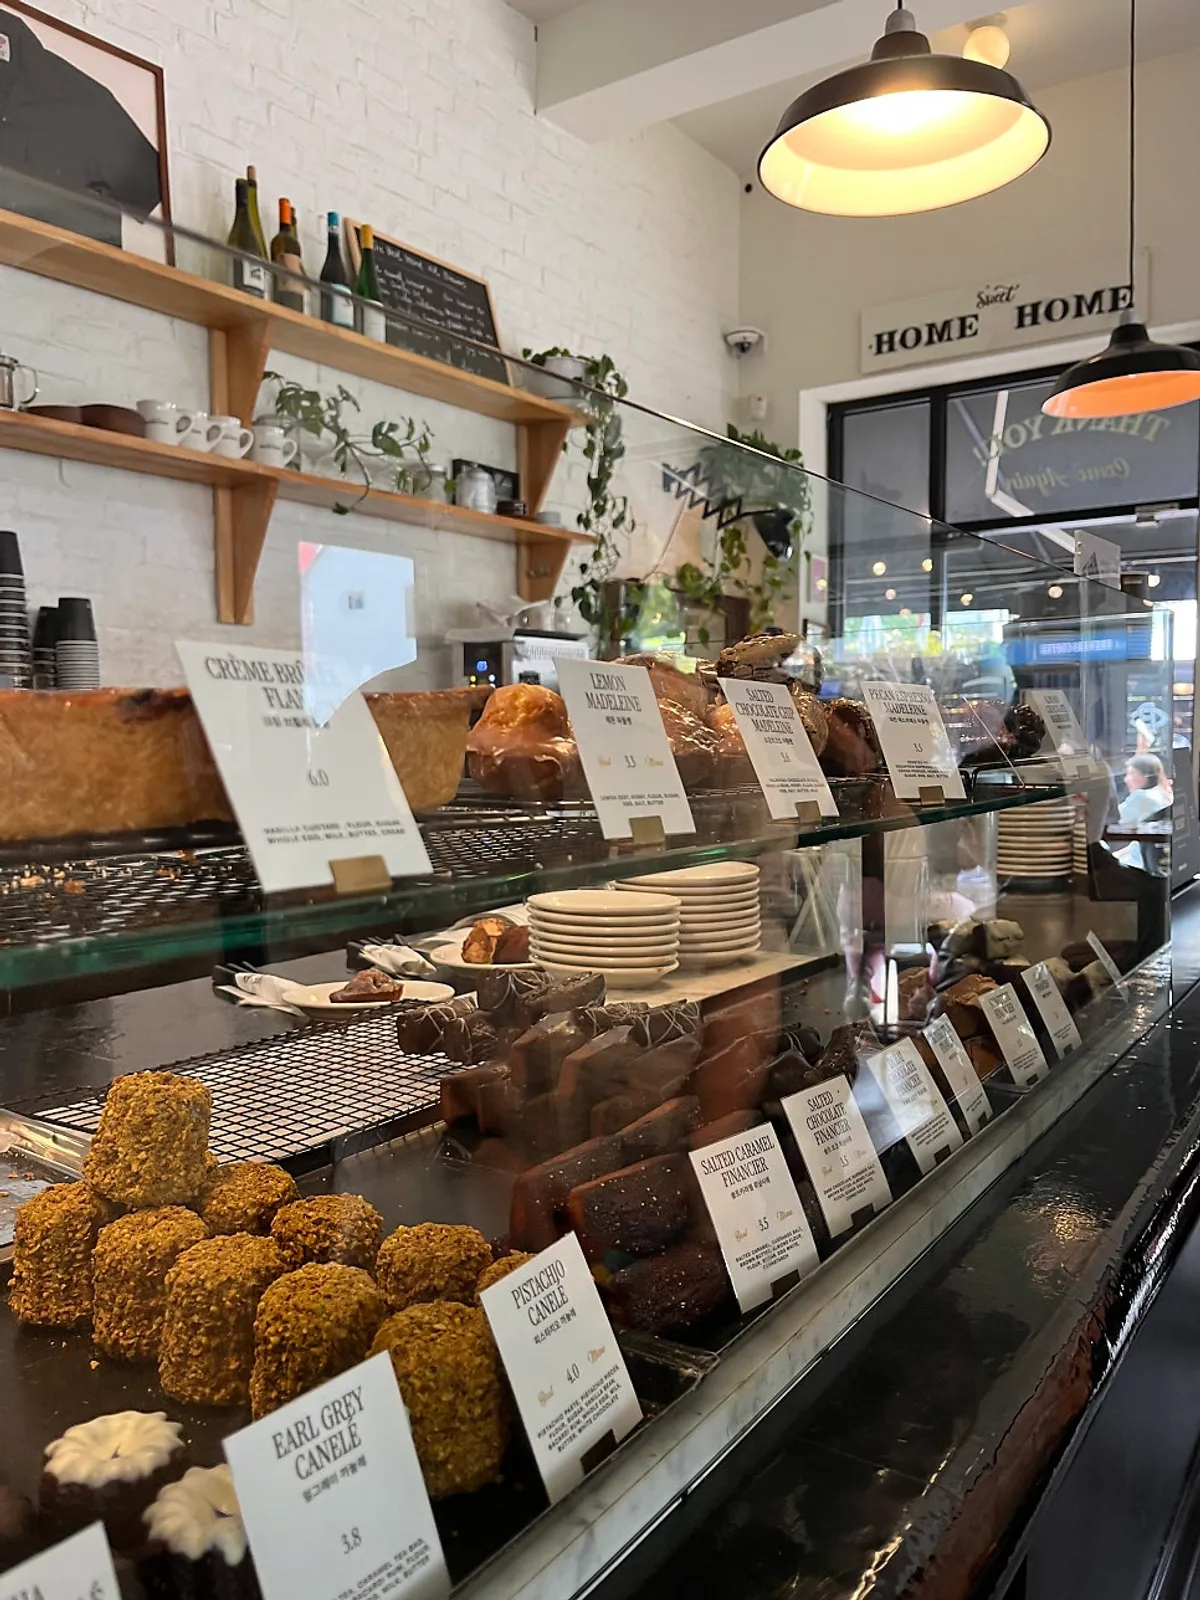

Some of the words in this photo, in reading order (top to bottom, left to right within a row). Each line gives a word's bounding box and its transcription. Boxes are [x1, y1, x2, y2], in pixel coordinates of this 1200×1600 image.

[874, 313, 979, 356] HOME
[1014, 284, 1135, 330] HOME
[205, 653, 275, 682] CRÈME
[589, 672, 626, 691] LEMON
[585, 692, 641, 712] MADELEINE
[745, 688, 774, 702] SALTED
[868, 688, 895, 700] PECAN
[735, 702, 779, 717] CHOCOLATE
[777, 706, 795, 719] CHIP
[884, 702, 927, 715] MADELEINE
[751, 719, 793, 733] MADELEINE
[307, 769, 329, 786] 6.0
[807, 1091, 833, 1112] SALTED
[806, 1102, 846, 1130] CHOCOLATE
[814, 1119, 851, 1145] FINANCIER
[701, 1150, 736, 1175] SALTED
[735, 1135, 775, 1161] CARAMEL
[721, 1157, 768, 1187] FINANCIER
[758, 1216, 769, 1232] 3.5
[566, 1363, 580, 1384] 4.0
[272, 1416, 320, 1459] EARL
[321, 1386, 365, 1430] GREY
[294, 1416, 361, 1479] CANELÉ
[341, 1527, 362, 1555] 3.8
